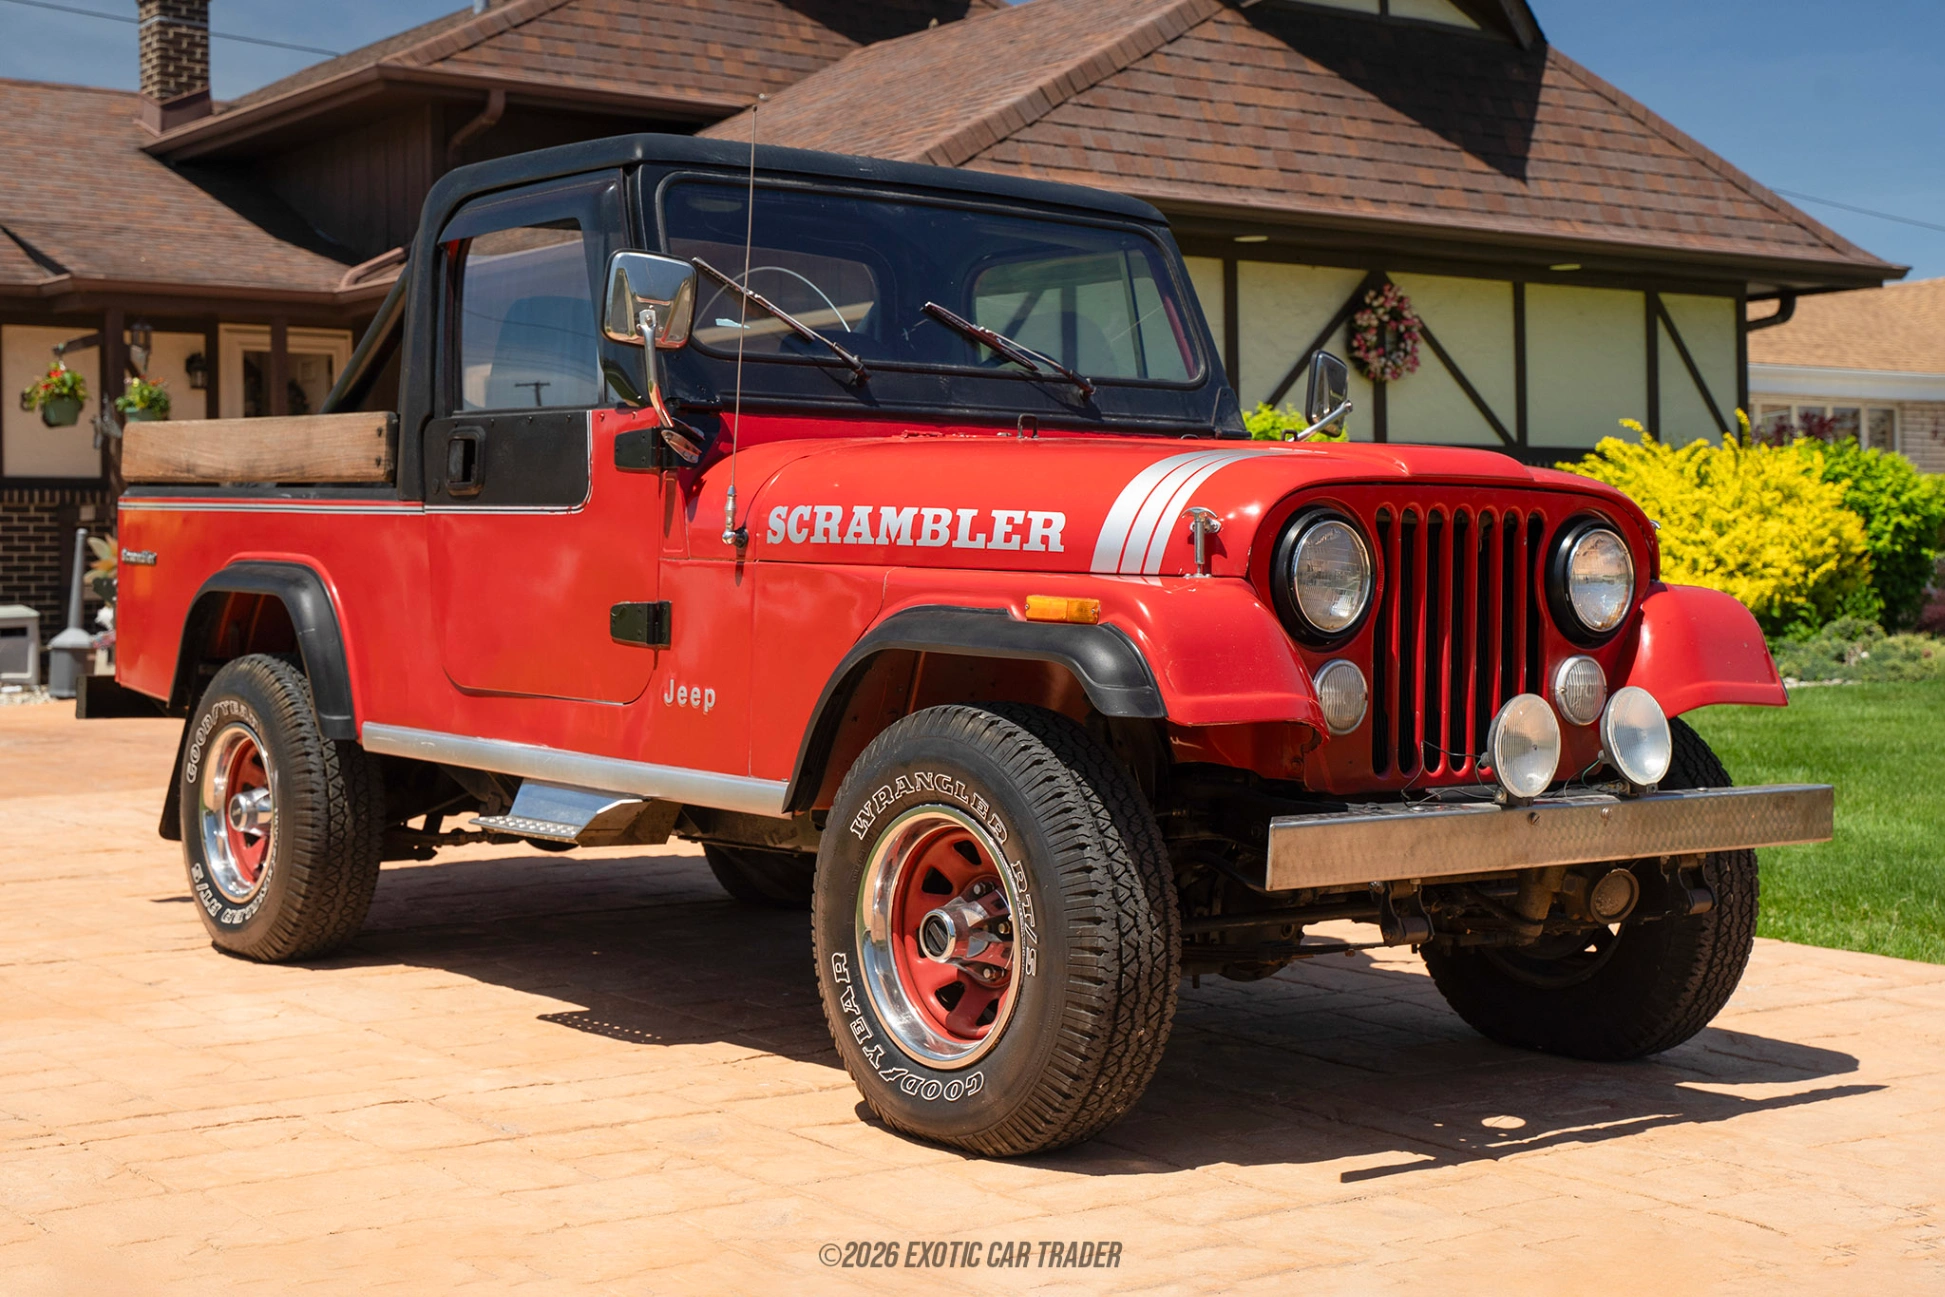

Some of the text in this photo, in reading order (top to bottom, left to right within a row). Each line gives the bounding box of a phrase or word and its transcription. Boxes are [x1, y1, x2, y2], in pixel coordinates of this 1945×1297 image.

[766, 505, 1066, 552] SCRAMBLER
[664, 679, 716, 713] Jeep
[850, 771, 1038, 977] WRANGLER RT/S
[832, 952, 984, 1101] GOODYEAR
